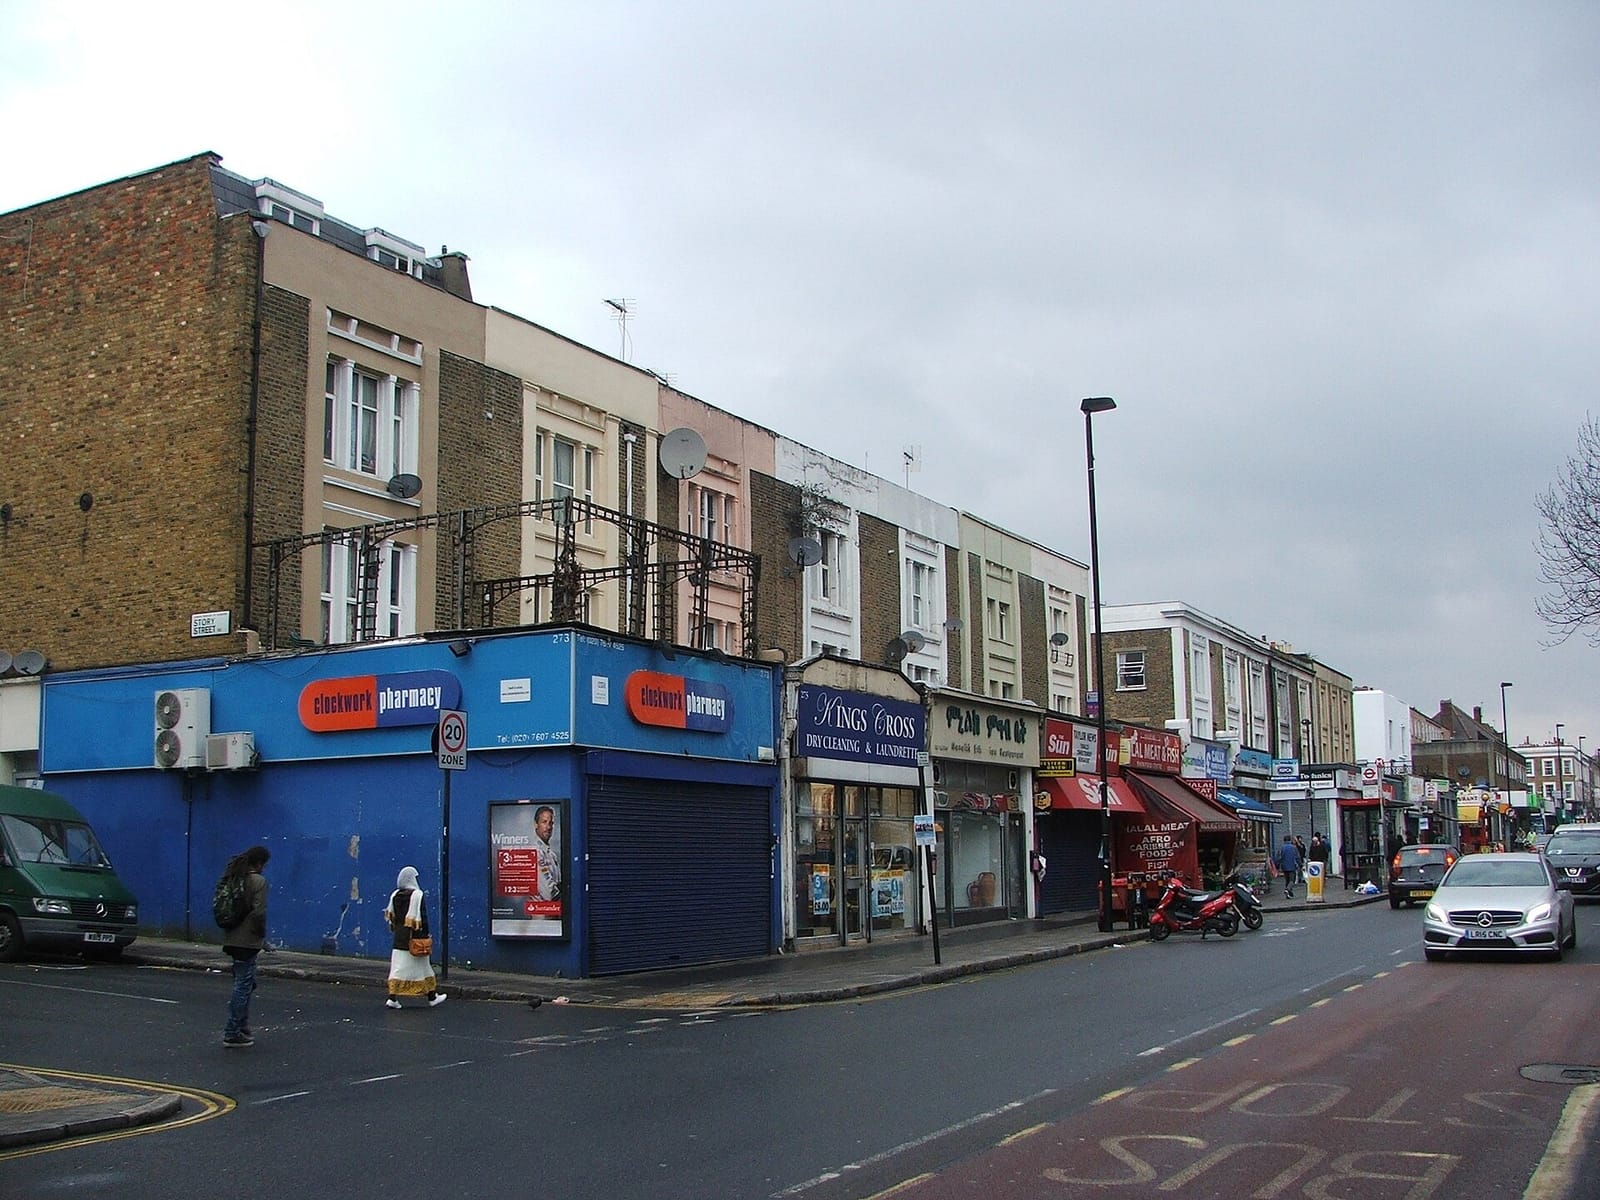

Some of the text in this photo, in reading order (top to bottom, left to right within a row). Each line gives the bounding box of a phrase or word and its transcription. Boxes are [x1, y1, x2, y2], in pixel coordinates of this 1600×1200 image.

[193, 617, 215, 627] STORY
[193, 625, 216, 635] STREET
[552, 633, 570, 644] 273
[313, 686, 442, 715] clockwork pharmacy
[640, 684, 684, 712] clockwork
[686, 691, 726, 721] pharmacy
[871, 702, 916, 739] CROSS
[444, 724, 463, 741] 20
[496, 735, 510, 744] Tel:
[531, 732, 549, 742] 7607
[551, 731, 570, 741] 4525
[865, 741, 873, 754] &
[1047, 734, 1070, 756] Sun
[1104, 747, 1118, 763] un
[1144, 743, 1161, 761] MEAT
[1161, 746, 1167, 762] &
[1167, 747, 1180, 764] FISH
[440, 754, 465, 766] ZONE
[1077, 778, 1122, 805] Sn
[1160, 822, 1190, 832] MEAT
[491, 833, 529, 845] Winners
[1141, 835, 1171, 844] AFRO
[1129, 840, 1185, 852] CARIBBEAN
[1139, 849, 1175, 859] FOODS
[1147, 861, 1169, 870] FISH
[535, 904, 561, 912] Santander
[1488, 930, 1504, 938] CNC
[1042, 1134, 1463, 1200] BUS
